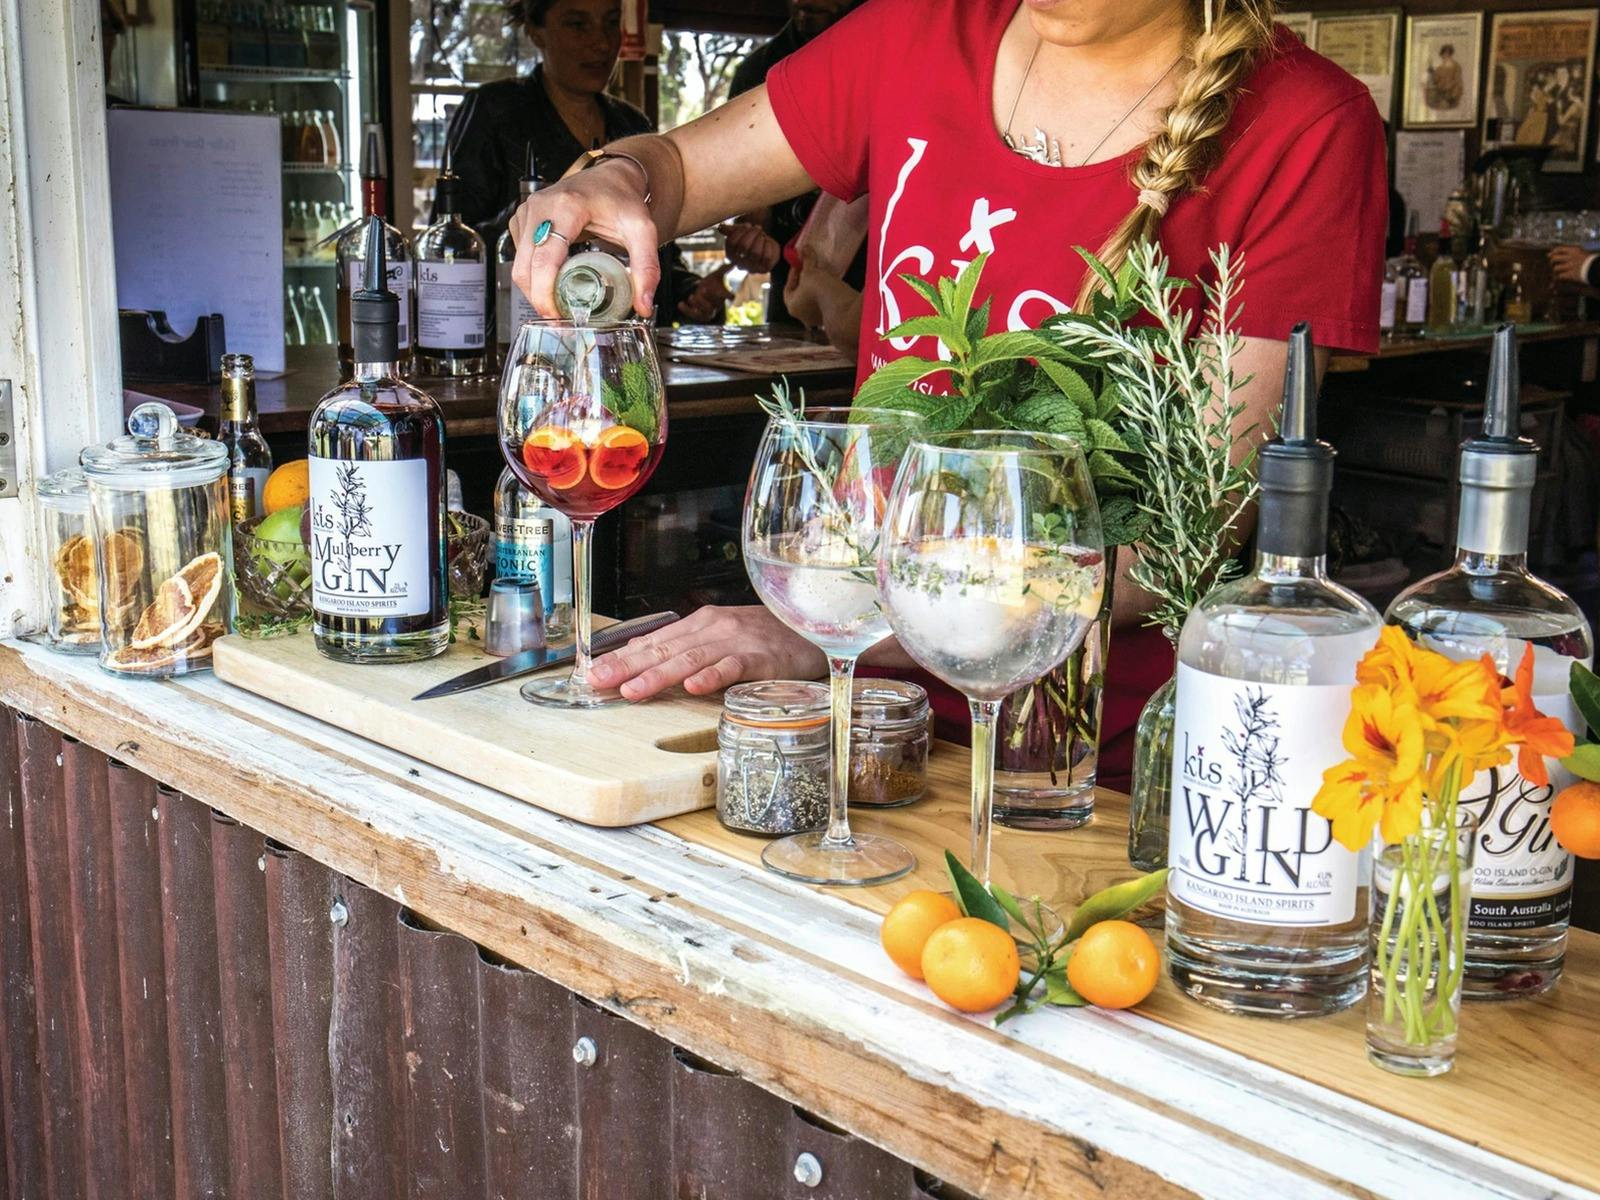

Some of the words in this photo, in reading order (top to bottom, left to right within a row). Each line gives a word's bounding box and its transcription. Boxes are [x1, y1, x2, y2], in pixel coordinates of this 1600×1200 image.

[312, 497, 334, 529] kis
[314, 533, 402, 573] Mulberry
[322, 559, 388, 594] GIN
[371, 600, 398, 608] SPIRITS
[1183, 731, 1222, 785] kis
[1195, 828, 1302, 889] GIN
[1494, 867, 1528, 877] ISLAND
[1186, 880, 1234, 902] KANGAROO
[1235, 894, 1274, 908] ISLAND
[1276, 899, 1315, 910] SPIRITS
[1474, 903, 1506, 915] South
[1510, 902, 1552, 914] Australia
